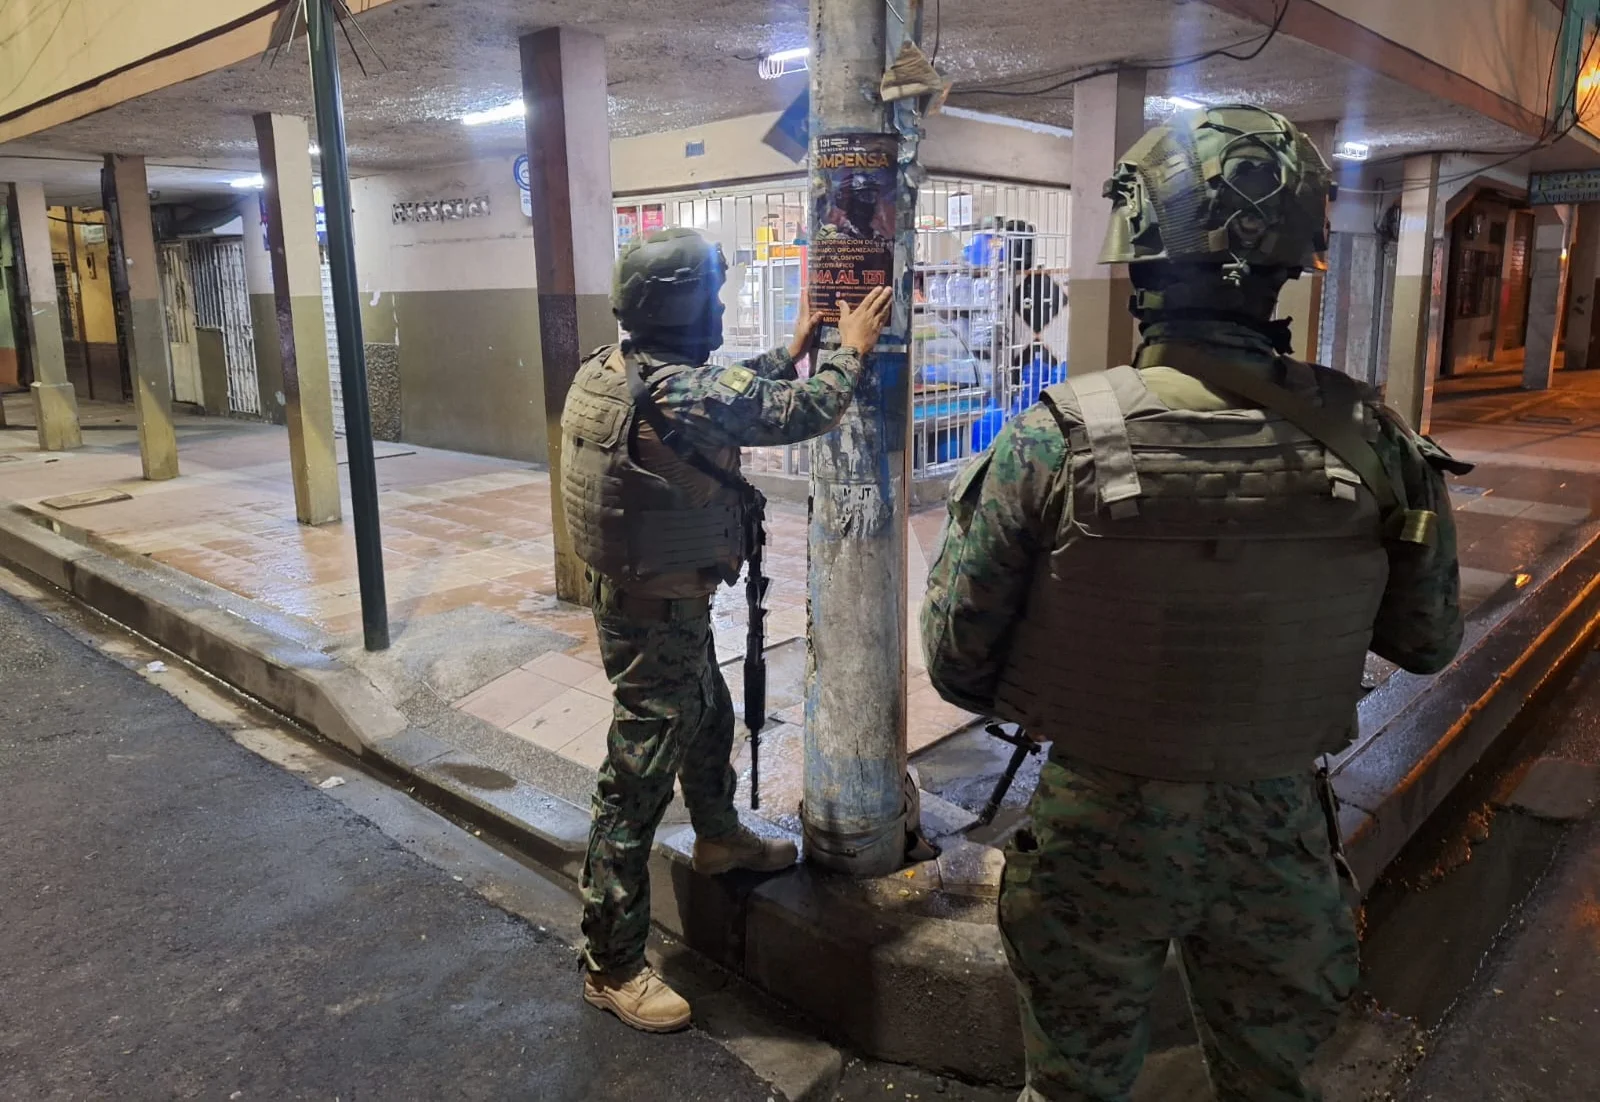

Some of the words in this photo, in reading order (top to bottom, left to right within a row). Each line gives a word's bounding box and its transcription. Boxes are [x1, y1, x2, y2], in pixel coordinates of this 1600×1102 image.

[820, 138, 830, 148] 131
[835, 269, 859, 284] AL
[862, 270, 886, 284] 131
